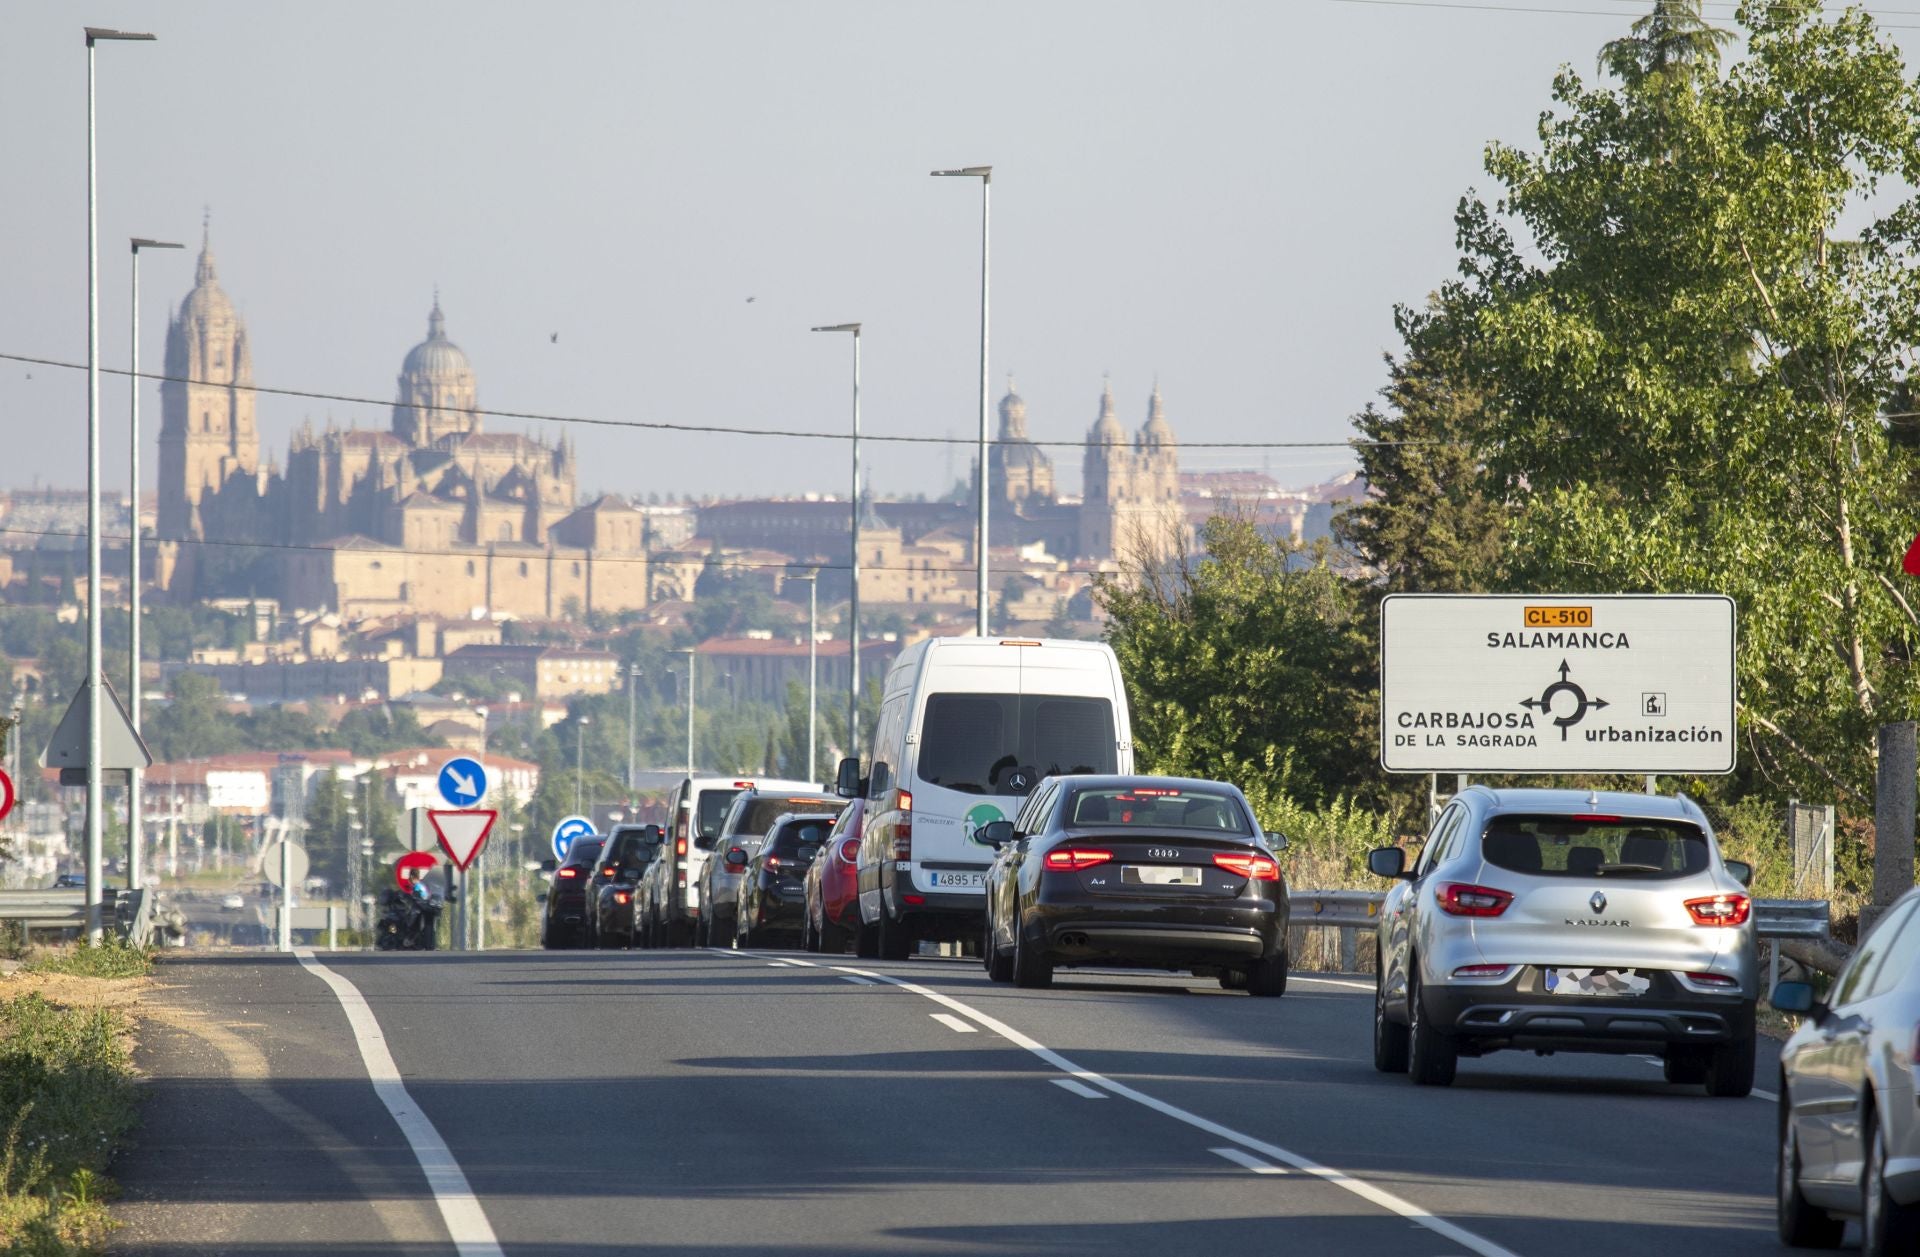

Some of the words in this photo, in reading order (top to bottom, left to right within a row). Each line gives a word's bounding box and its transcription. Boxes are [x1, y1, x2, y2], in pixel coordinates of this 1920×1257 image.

[1528, 610, 1588, 624] CL-510
[1487, 632, 1630, 649] SALAMANCA
[1397, 712, 1535, 729] CARBAJOSA
[1395, 735, 1417, 747] DE
[1426, 735, 1446, 747] LA
[1456, 735, 1537, 747] SAGRADA
[1585, 725, 1723, 743] urbanización
[940, 874, 969, 886] 4895
[973, 874, 987, 887] FY
[1564, 919, 1630, 928] KADJAR
